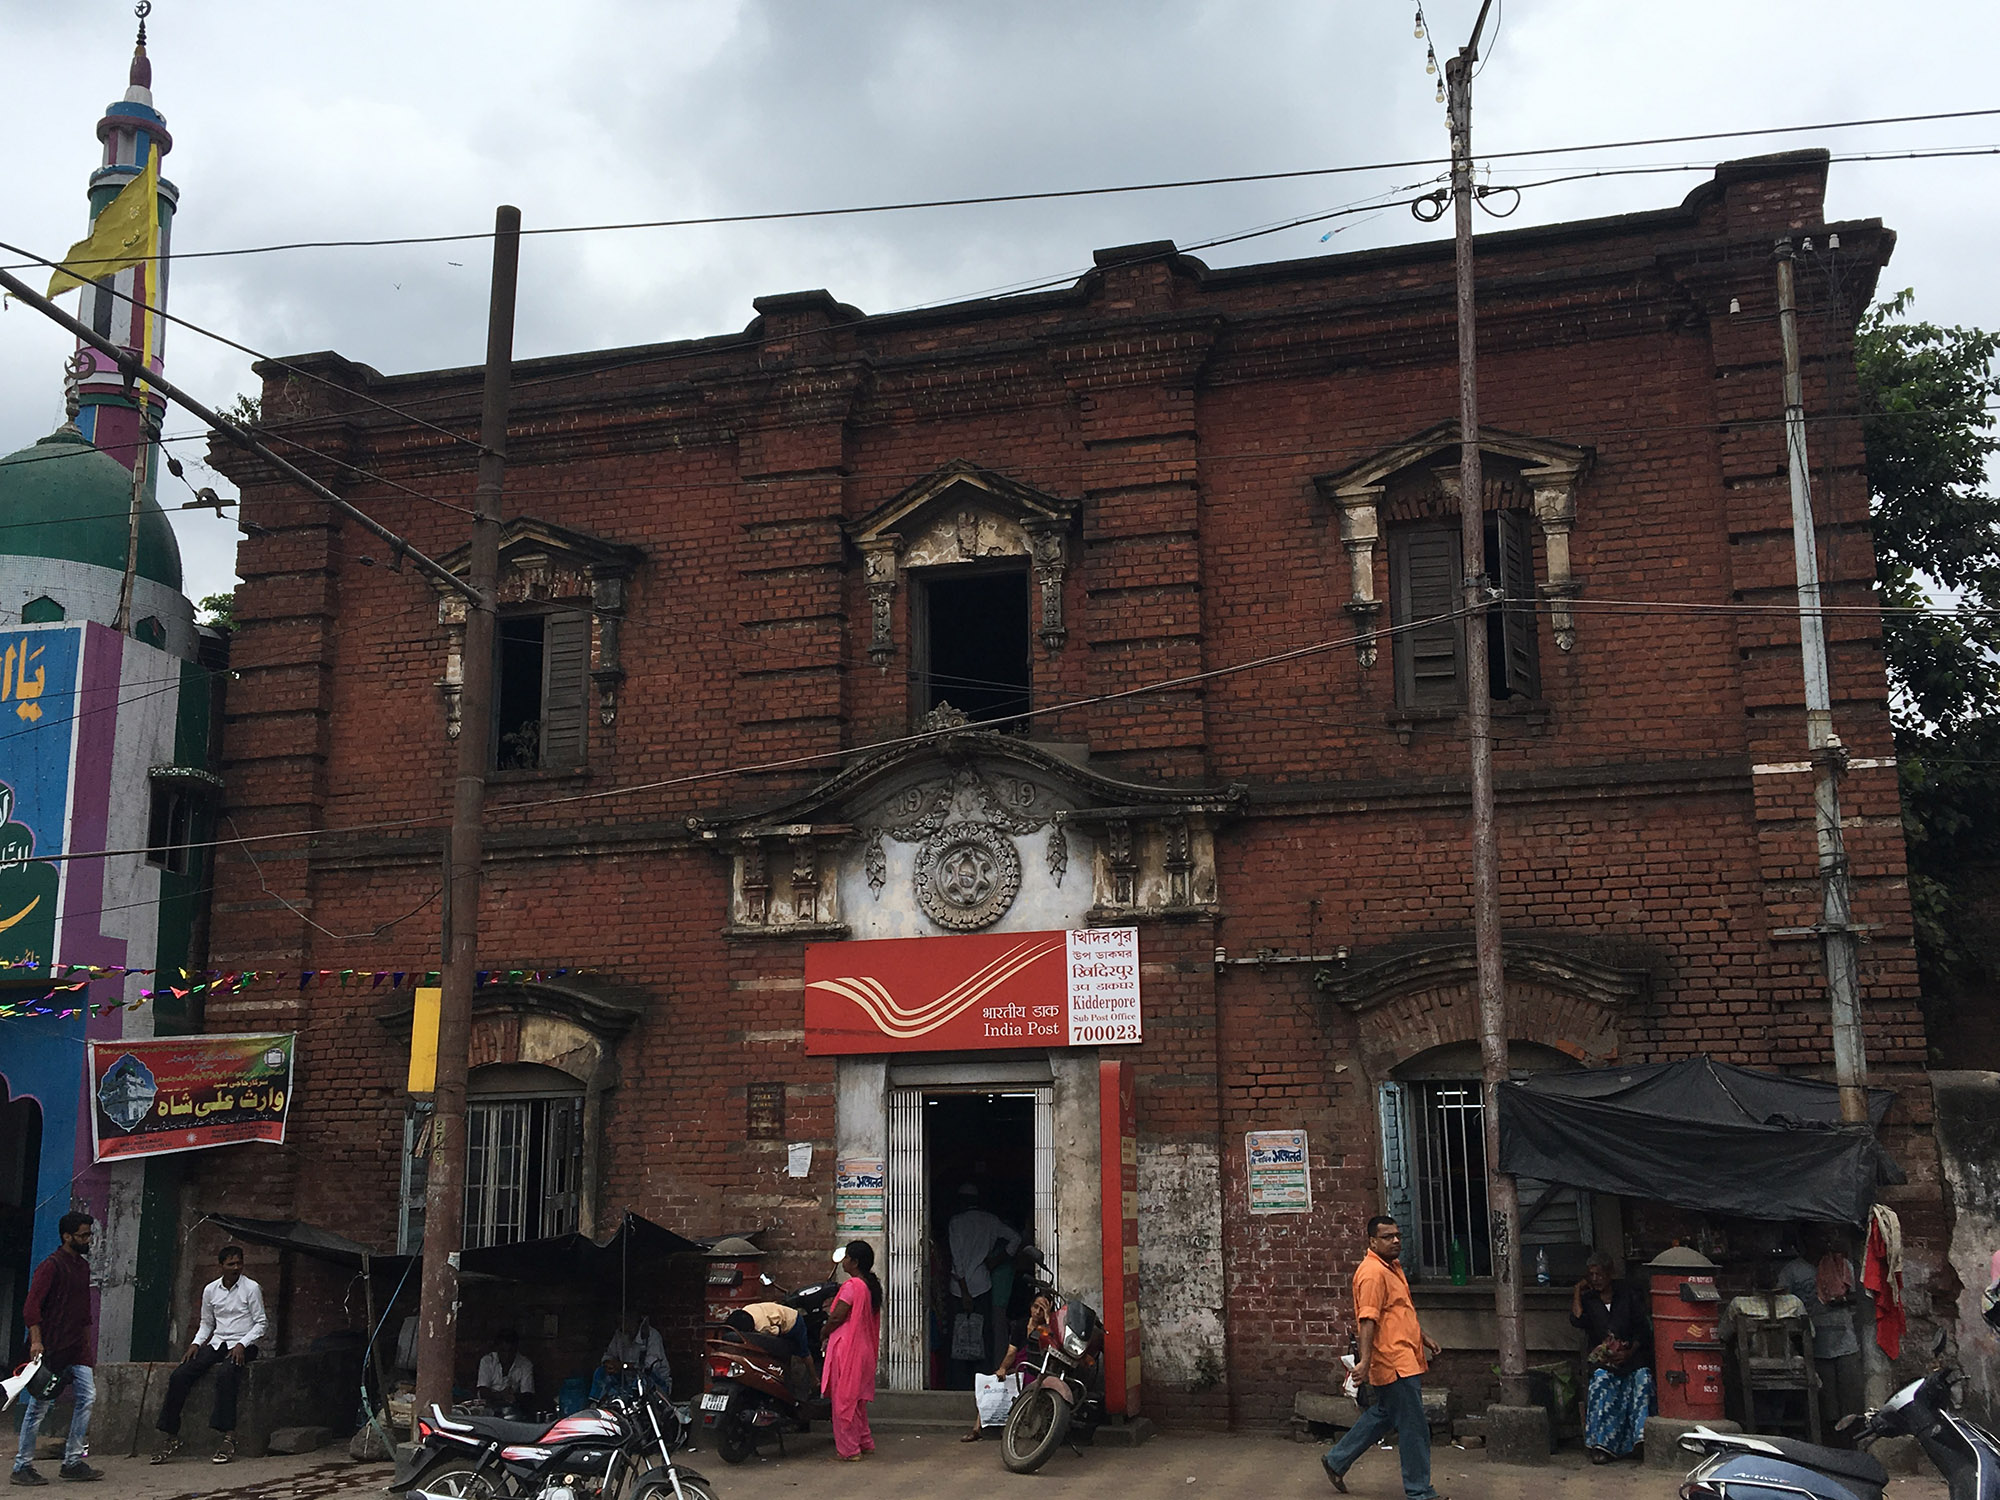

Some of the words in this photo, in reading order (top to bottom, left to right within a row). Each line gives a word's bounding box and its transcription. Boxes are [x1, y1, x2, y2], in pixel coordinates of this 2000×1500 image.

[1072, 963, 1134, 981] खिदिरपुर
[982, 1002, 1027, 1019] भारतीय
[1032, 1005, 1060, 1018] डाक
[1073, 994, 1136, 1012] Kidderpore
[1073, 1014, 1089, 1022] Sub
[1091, 1014, 1109, 1022] Post
[1110, 1012, 1136, 1021] Office
[984, 1022, 1023, 1037] India
[1027, 1021, 1060, 1036] Post
